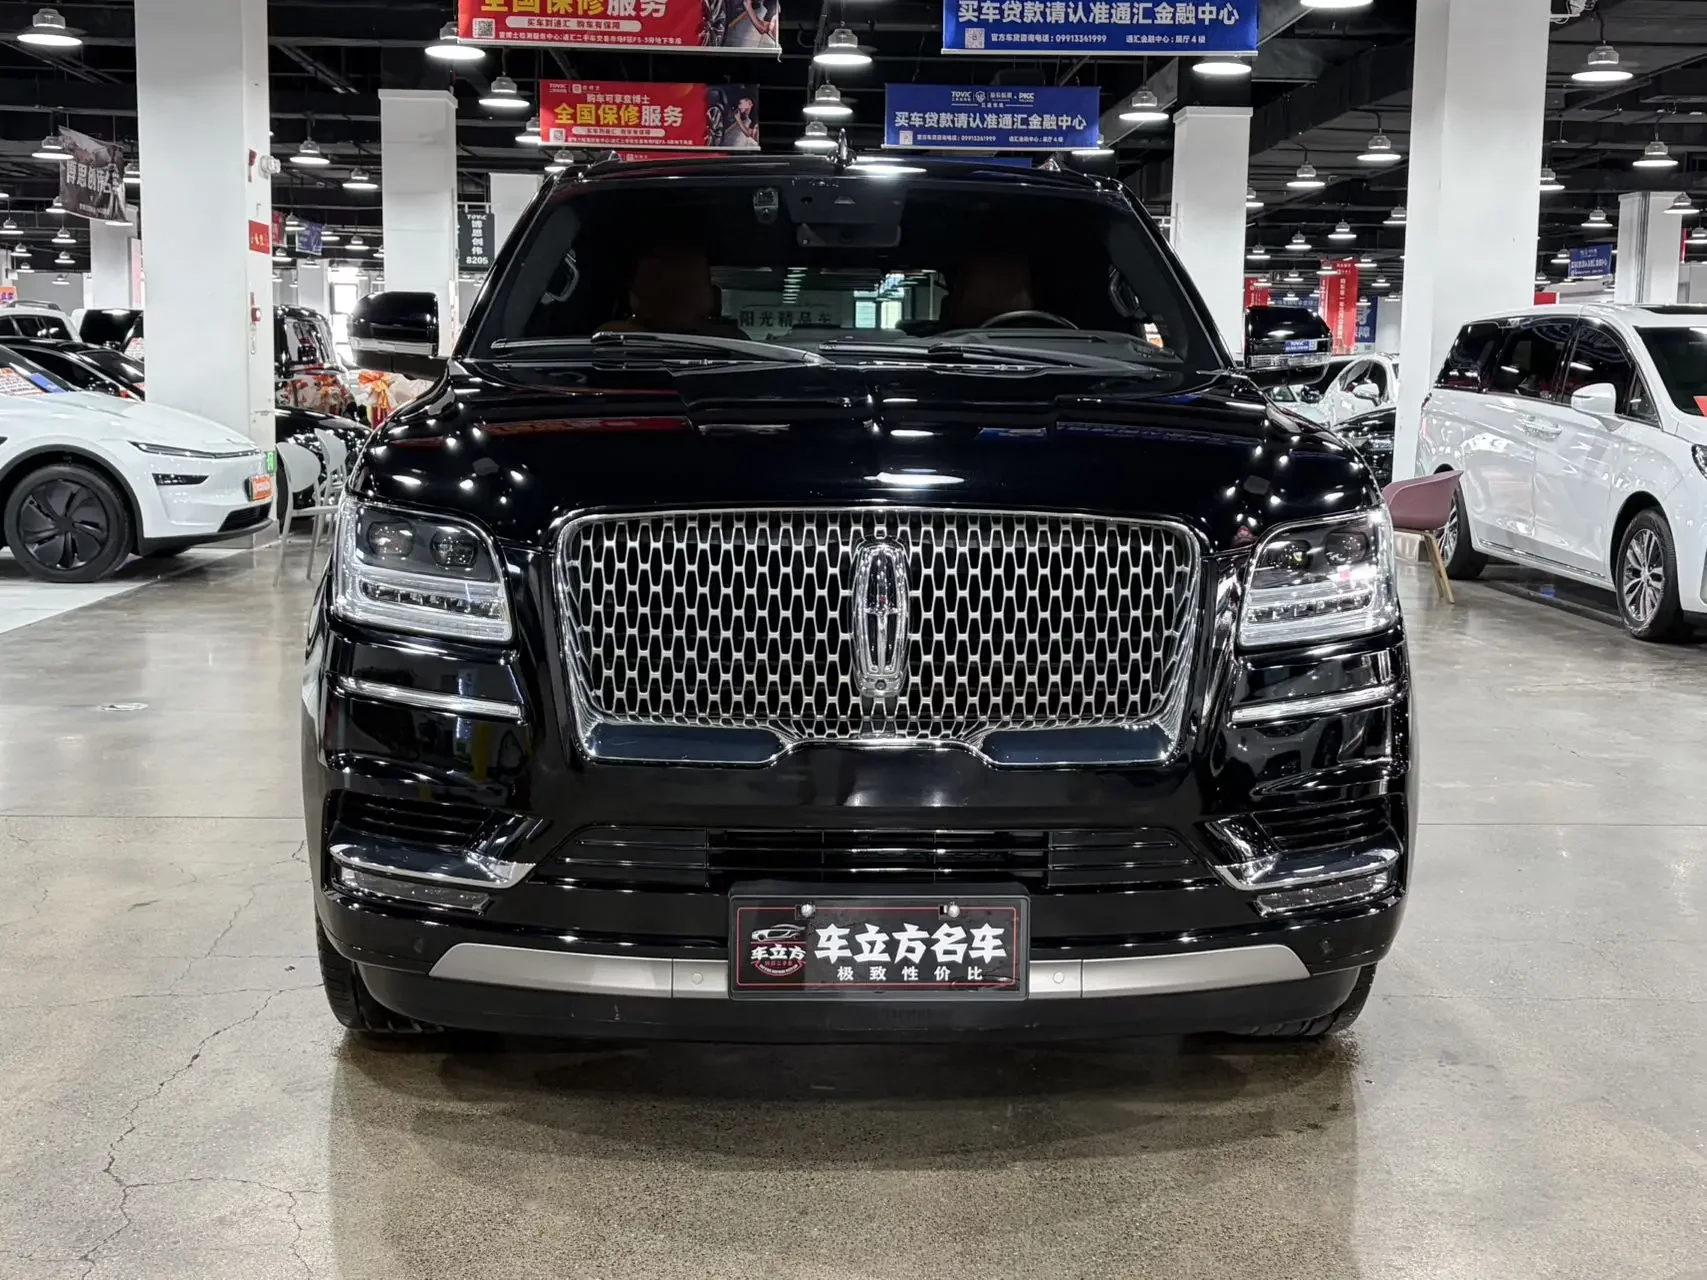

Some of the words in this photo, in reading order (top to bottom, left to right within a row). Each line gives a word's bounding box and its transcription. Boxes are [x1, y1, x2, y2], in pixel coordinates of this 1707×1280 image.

[958, 1, 1239, 25] 买车贷款请认准通汇金融中心
[553, 102, 683, 127] 全国保修服务
[894, 111, 1087, 131] 买车贷款请认准通汇金融中心
[466, 256, 489, 265] 8205
[750, 943, 807, 961] 车立方
[814, 923, 1007, 964] 车立方名车
[837, 965, 983, 982] 极致性价比
